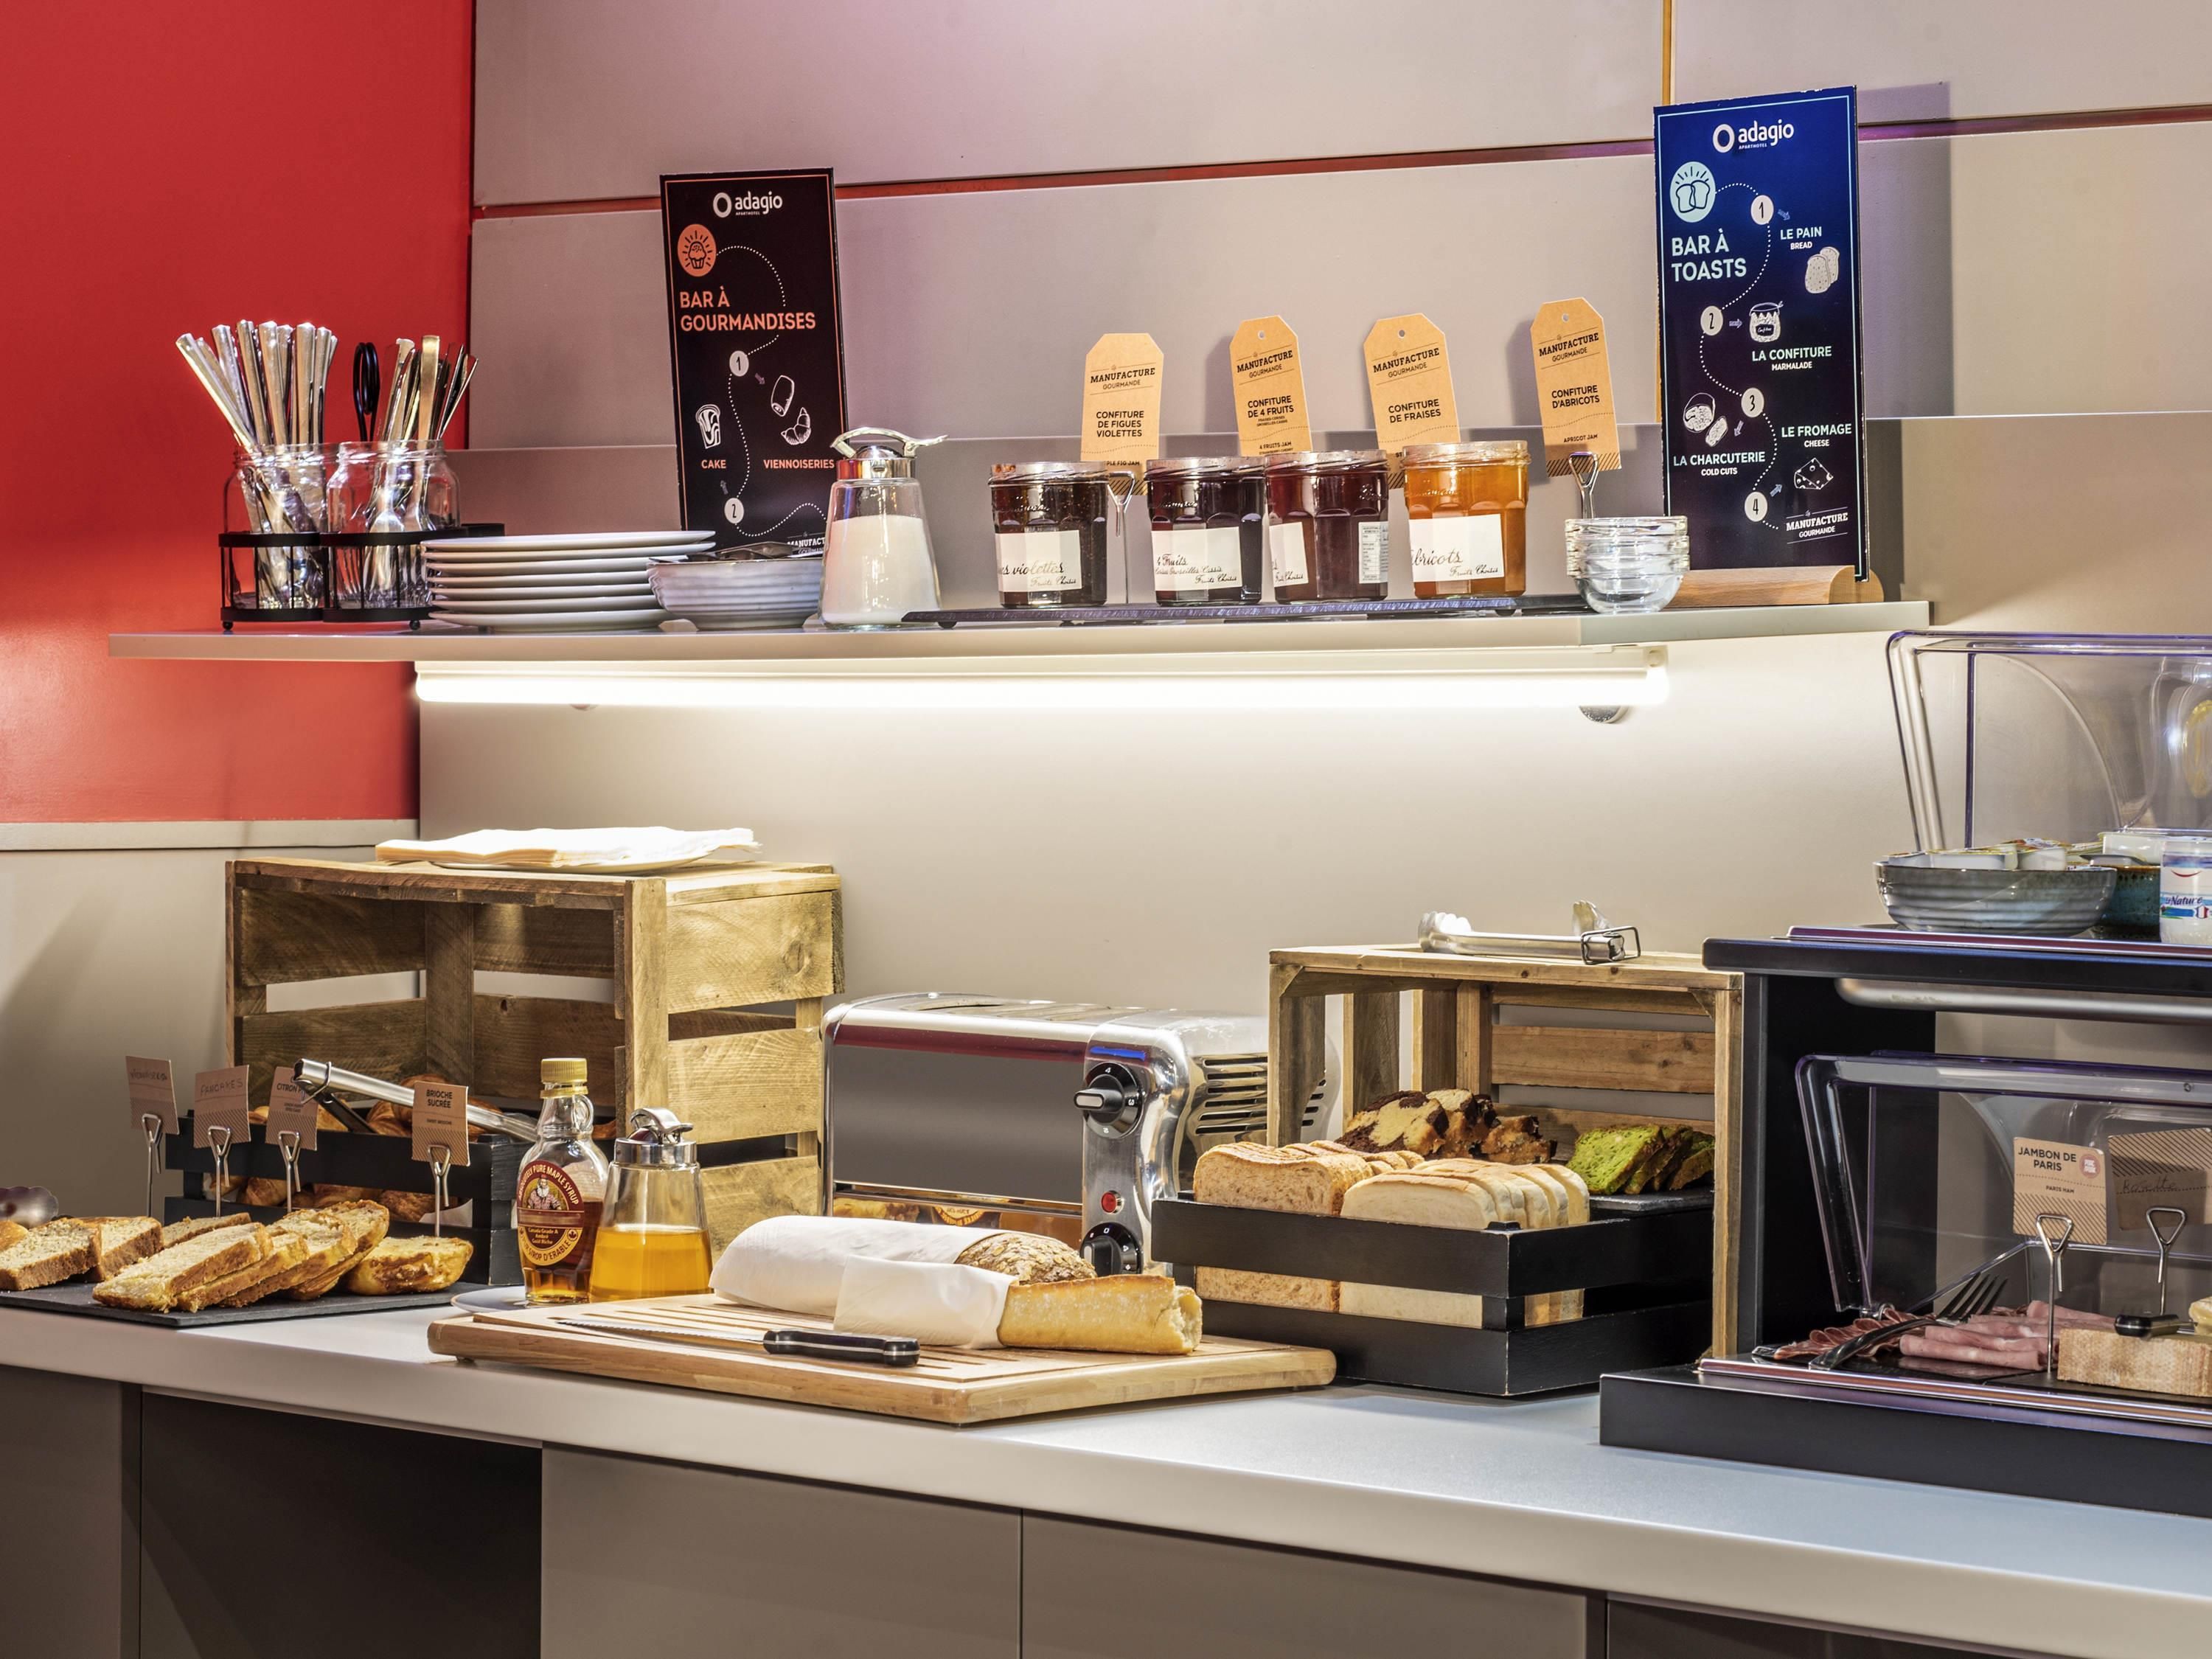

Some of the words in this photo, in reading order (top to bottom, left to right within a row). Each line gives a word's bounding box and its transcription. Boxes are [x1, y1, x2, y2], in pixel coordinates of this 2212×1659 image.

[1738, 119, 1795, 146] adagio
[734, 190, 783, 215] adagio
[1759, 201, 1764, 219] 1
[1780, 229, 1793, 240] LE
[1796, 226, 1822, 238] PAIN
[1672, 235, 1710, 257] BAR
[1715, 228, 1729, 253] À
[1790, 241, 1812, 250] BREAD
[1671, 258, 1747, 282] TOASTS
[680, 291, 714, 308] BAR
[717, 285, 730, 307] À
[681, 312, 816, 331] GOURMANDISES
[1708, 313, 1714, 330] 2
[1539, 333, 1599, 357] MANUFACTURE
[1237, 349, 1293, 372] MANUFACTURE
[1373, 348, 1440, 372] MANUFACTURE
[1552, 347, 1587, 362] GOURMANDE
[1752, 350, 1766, 361] LA
[1770, 346, 1832, 360] CONFITURE
[736, 356, 741, 371] 1
[1388, 362, 1427, 378] GOURMANDE
[1772, 361, 1812, 371] MARMALADE
[1090, 368, 1155, 383] MANUFACTURE
[1249, 364, 1282, 378] GOURMANDE
[1102, 380, 1141, 390] GOURMANDE
[1551, 385, 1598, 399] CONFITURE
[1248, 395, 1291, 408] CONFITURE
[1388, 399, 1439, 413] CONFITURE
[1552, 395, 1600, 408] D'ABRICOTS
[1749, 394, 1755, 411] 3
[1096, 410, 1144, 419] CONFITURE
[1248, 410, 1258, 418] DE
[1267, 405, 1294, 415] FRUITS
[1389, 414, 1402, 423] DE
[1405, 408, 1441, 421] FRAISES
[1098, 420, 1109, 428] DE
[1111, 420, 1141, 428] FIGUES
[1781, 426, 1795, 438] LE
[1798, 423, 1852, 437] FROMAGE
[1096, 429, 1142, 438] VIOLETTES
[1563, 435, 1585, 443] APRICOT
[1804, 439, 1829, 448] CHEESE
[701, 459, 726, 469] CAKE
[763, 459, 835, 469] VIENNOISERIES
[1674, 456, 1687, 466] LA
[1690, 451, 1765, 465] CHARCUTERIE
[1701, 467, 1719, 476] COLD
[1720, 467, 1738, 476] CUTS
[731, 504, 737, 518] 2
[1753, 498, 1759, 515] 4
[1786, 512, 1848, 532] MANUFACTURE
[1799, 526, 1835, 538] GOURMANDE
[1162, 553, 1188, 566] Fruits
[1012, 560, 1064, 575] violettes
[2171, 895, 2203, 905] Nature
[276, 1083, 297, 1093] CITRON
[426, 1089, 453, 1099] BRIOCHE
[428, 1099, 451, 1108] SUCRÉE
[2018, 1147, 2061, 1160] JAMBON
[2063, 1152, 2077, 1163] DE
[2034, 1159, 2062, 1172] PARIS
[532, 1164, 546, 1173] PURE
[546, 1166, 566, 1185] MAPLE
[563, 1182, 580, 1205] SYRUP
